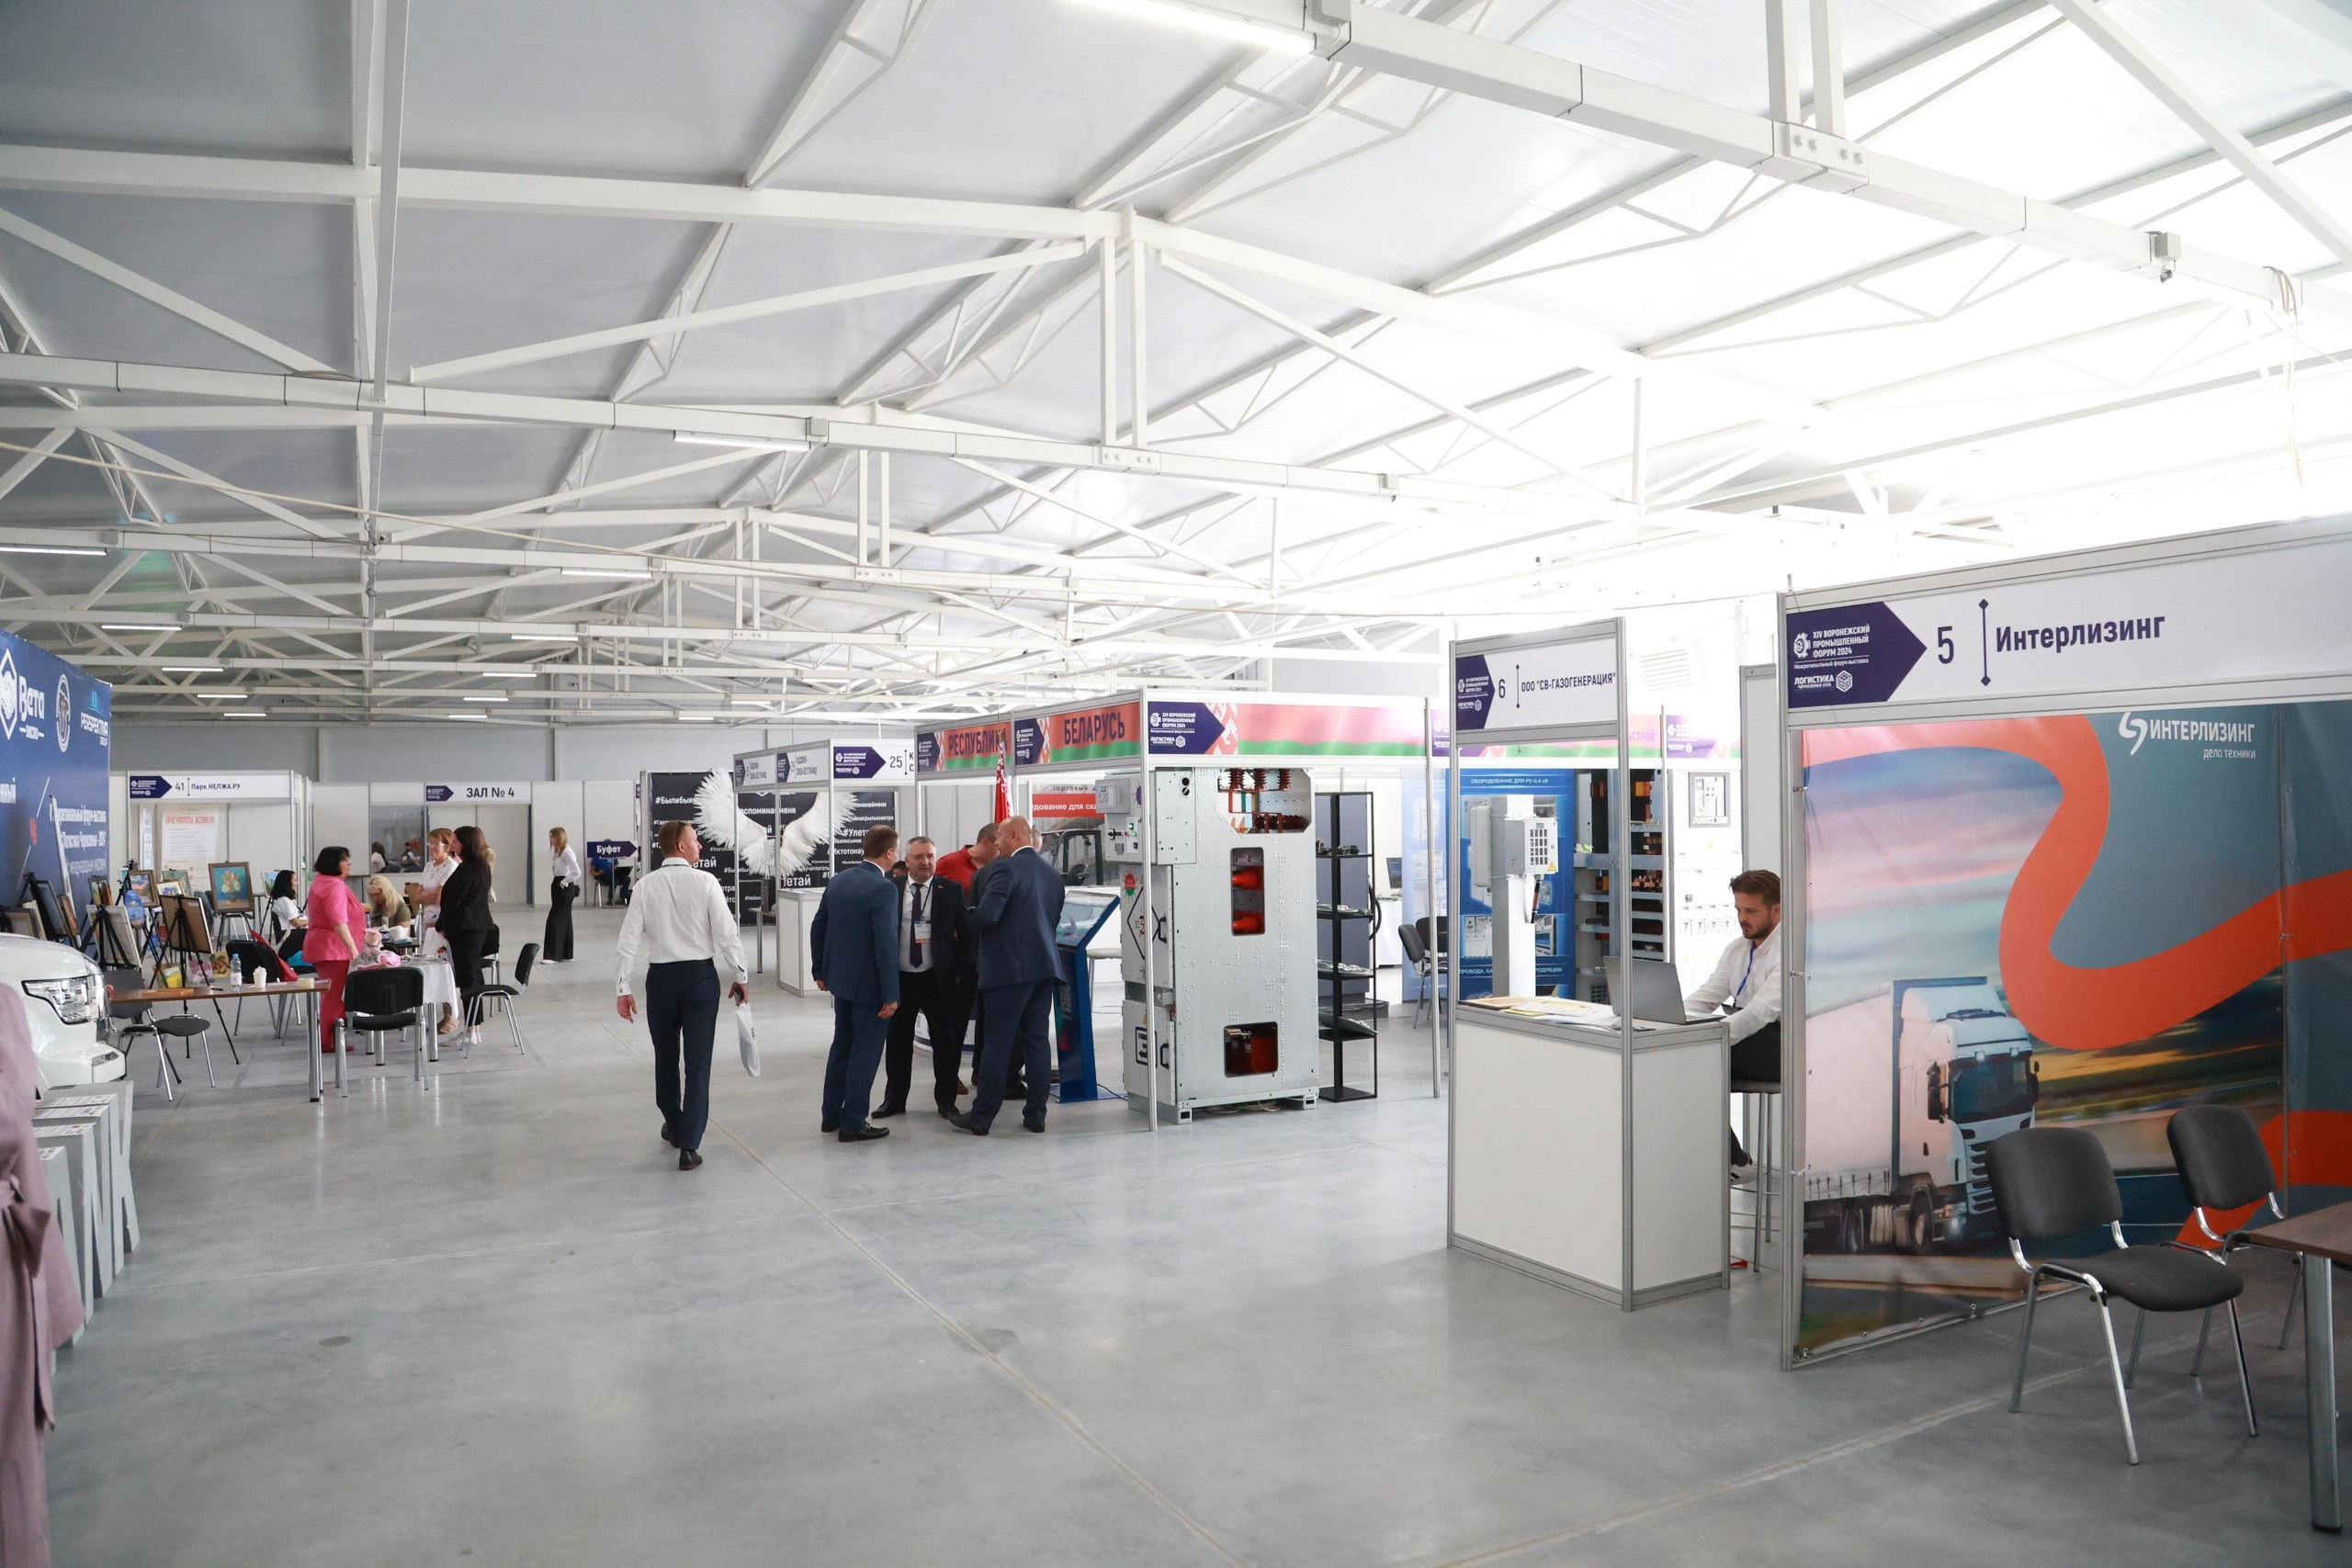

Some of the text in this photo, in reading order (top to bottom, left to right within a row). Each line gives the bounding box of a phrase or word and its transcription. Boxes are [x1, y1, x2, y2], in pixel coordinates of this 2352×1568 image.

[1824, 624, 1870, 637] ВОРОНЕЖСКИЙ
[1813, 634, 1869, 649] ПРОМЫШЛЕННЫЙ
[1938, 616, 2165, 664] 5 Интерлизинг
[1813, 647, 1852, 658] ФОРУМ 2024
[1794, 674, 1835, 685] ЛОГИСТИКА
[1498, 679, 1506, 698] 6
[1521, 681, 1535, 692] ООО
[1064, 712, 1125, 745] БЕЛАРУСЬ
[2150, 719, 2255, 743] ИНТЕРЛИЗИНГ
[2203, 749, 2256, 760] дело техники
[889, 756, 903, 768] 25
[175, 783, 185, 791] 41
[466, 787, 514, 797] ЗАЛ № 4
[655, 796, 695, 805] #Былибык
[1069, 803, 1084, 811] для
[596, 845, 621, 854] Буфет
[691, 856, 717, 868] етай
